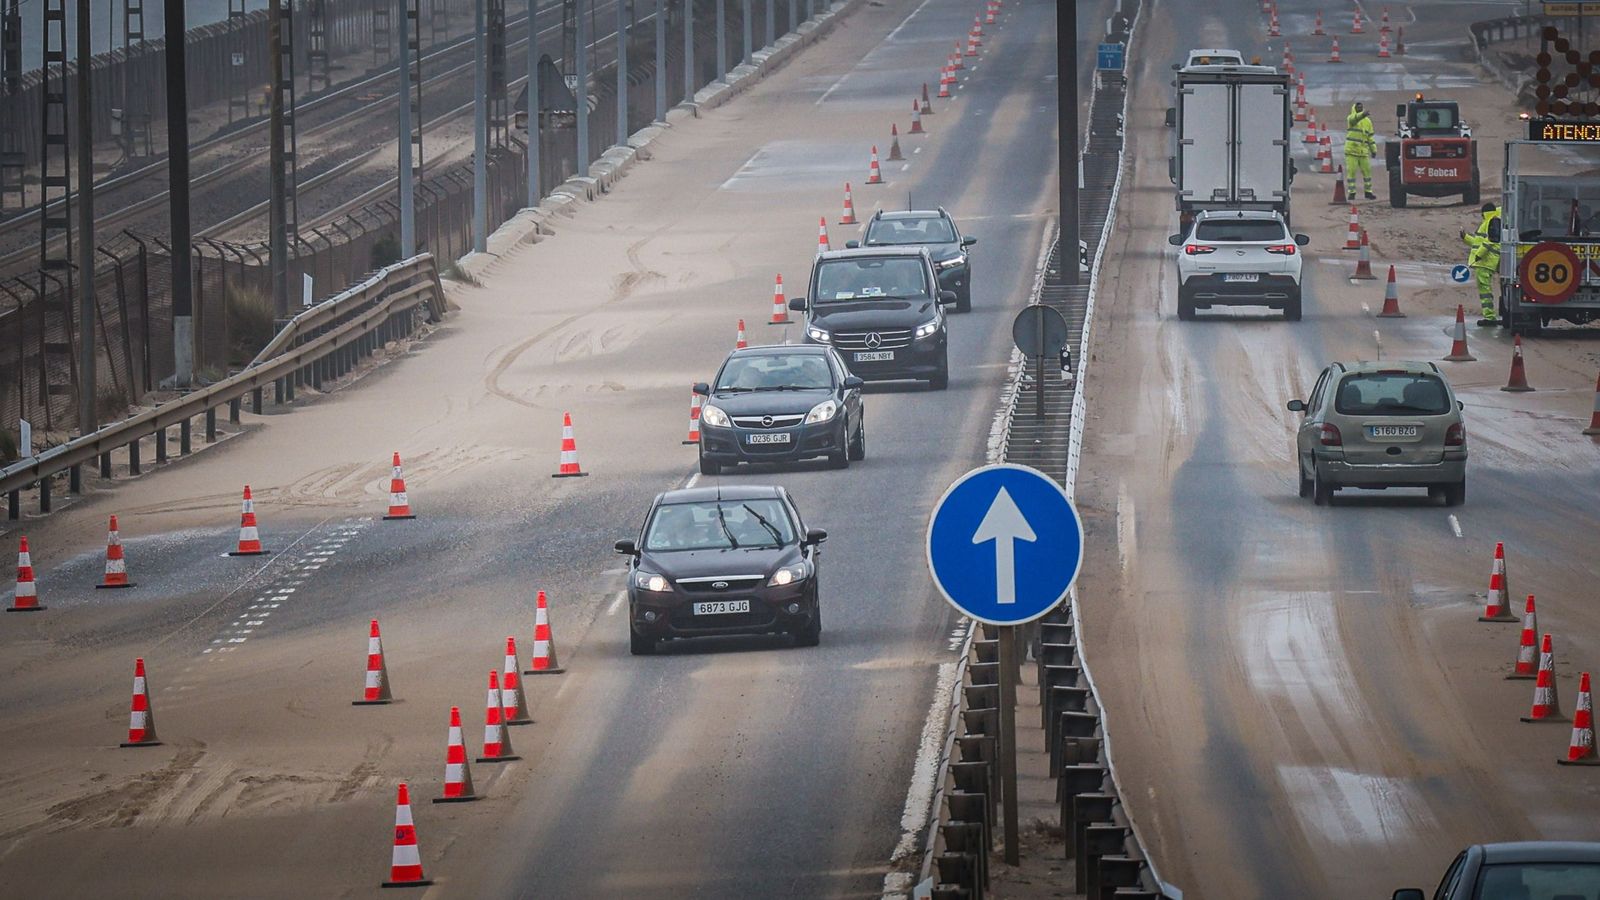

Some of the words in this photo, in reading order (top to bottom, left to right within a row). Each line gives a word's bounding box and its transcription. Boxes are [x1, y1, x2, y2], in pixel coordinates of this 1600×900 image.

[1543, 124, 1600, 140] ATENCI
[1428, 167, 1458, 177] Bobcat
[1534, 263, 1568, 284] 80
[858, 353, 876, 361] 3584
[1375, 426, 1397, 435] 5160
[1398, 426, 1415, 435] BZG
[752, 434, 771, 443] 0236
[773, 434, 788, 442] GJR
[700, 602, 725, 613] 6873
[729, 601, 748, 612] GJG
